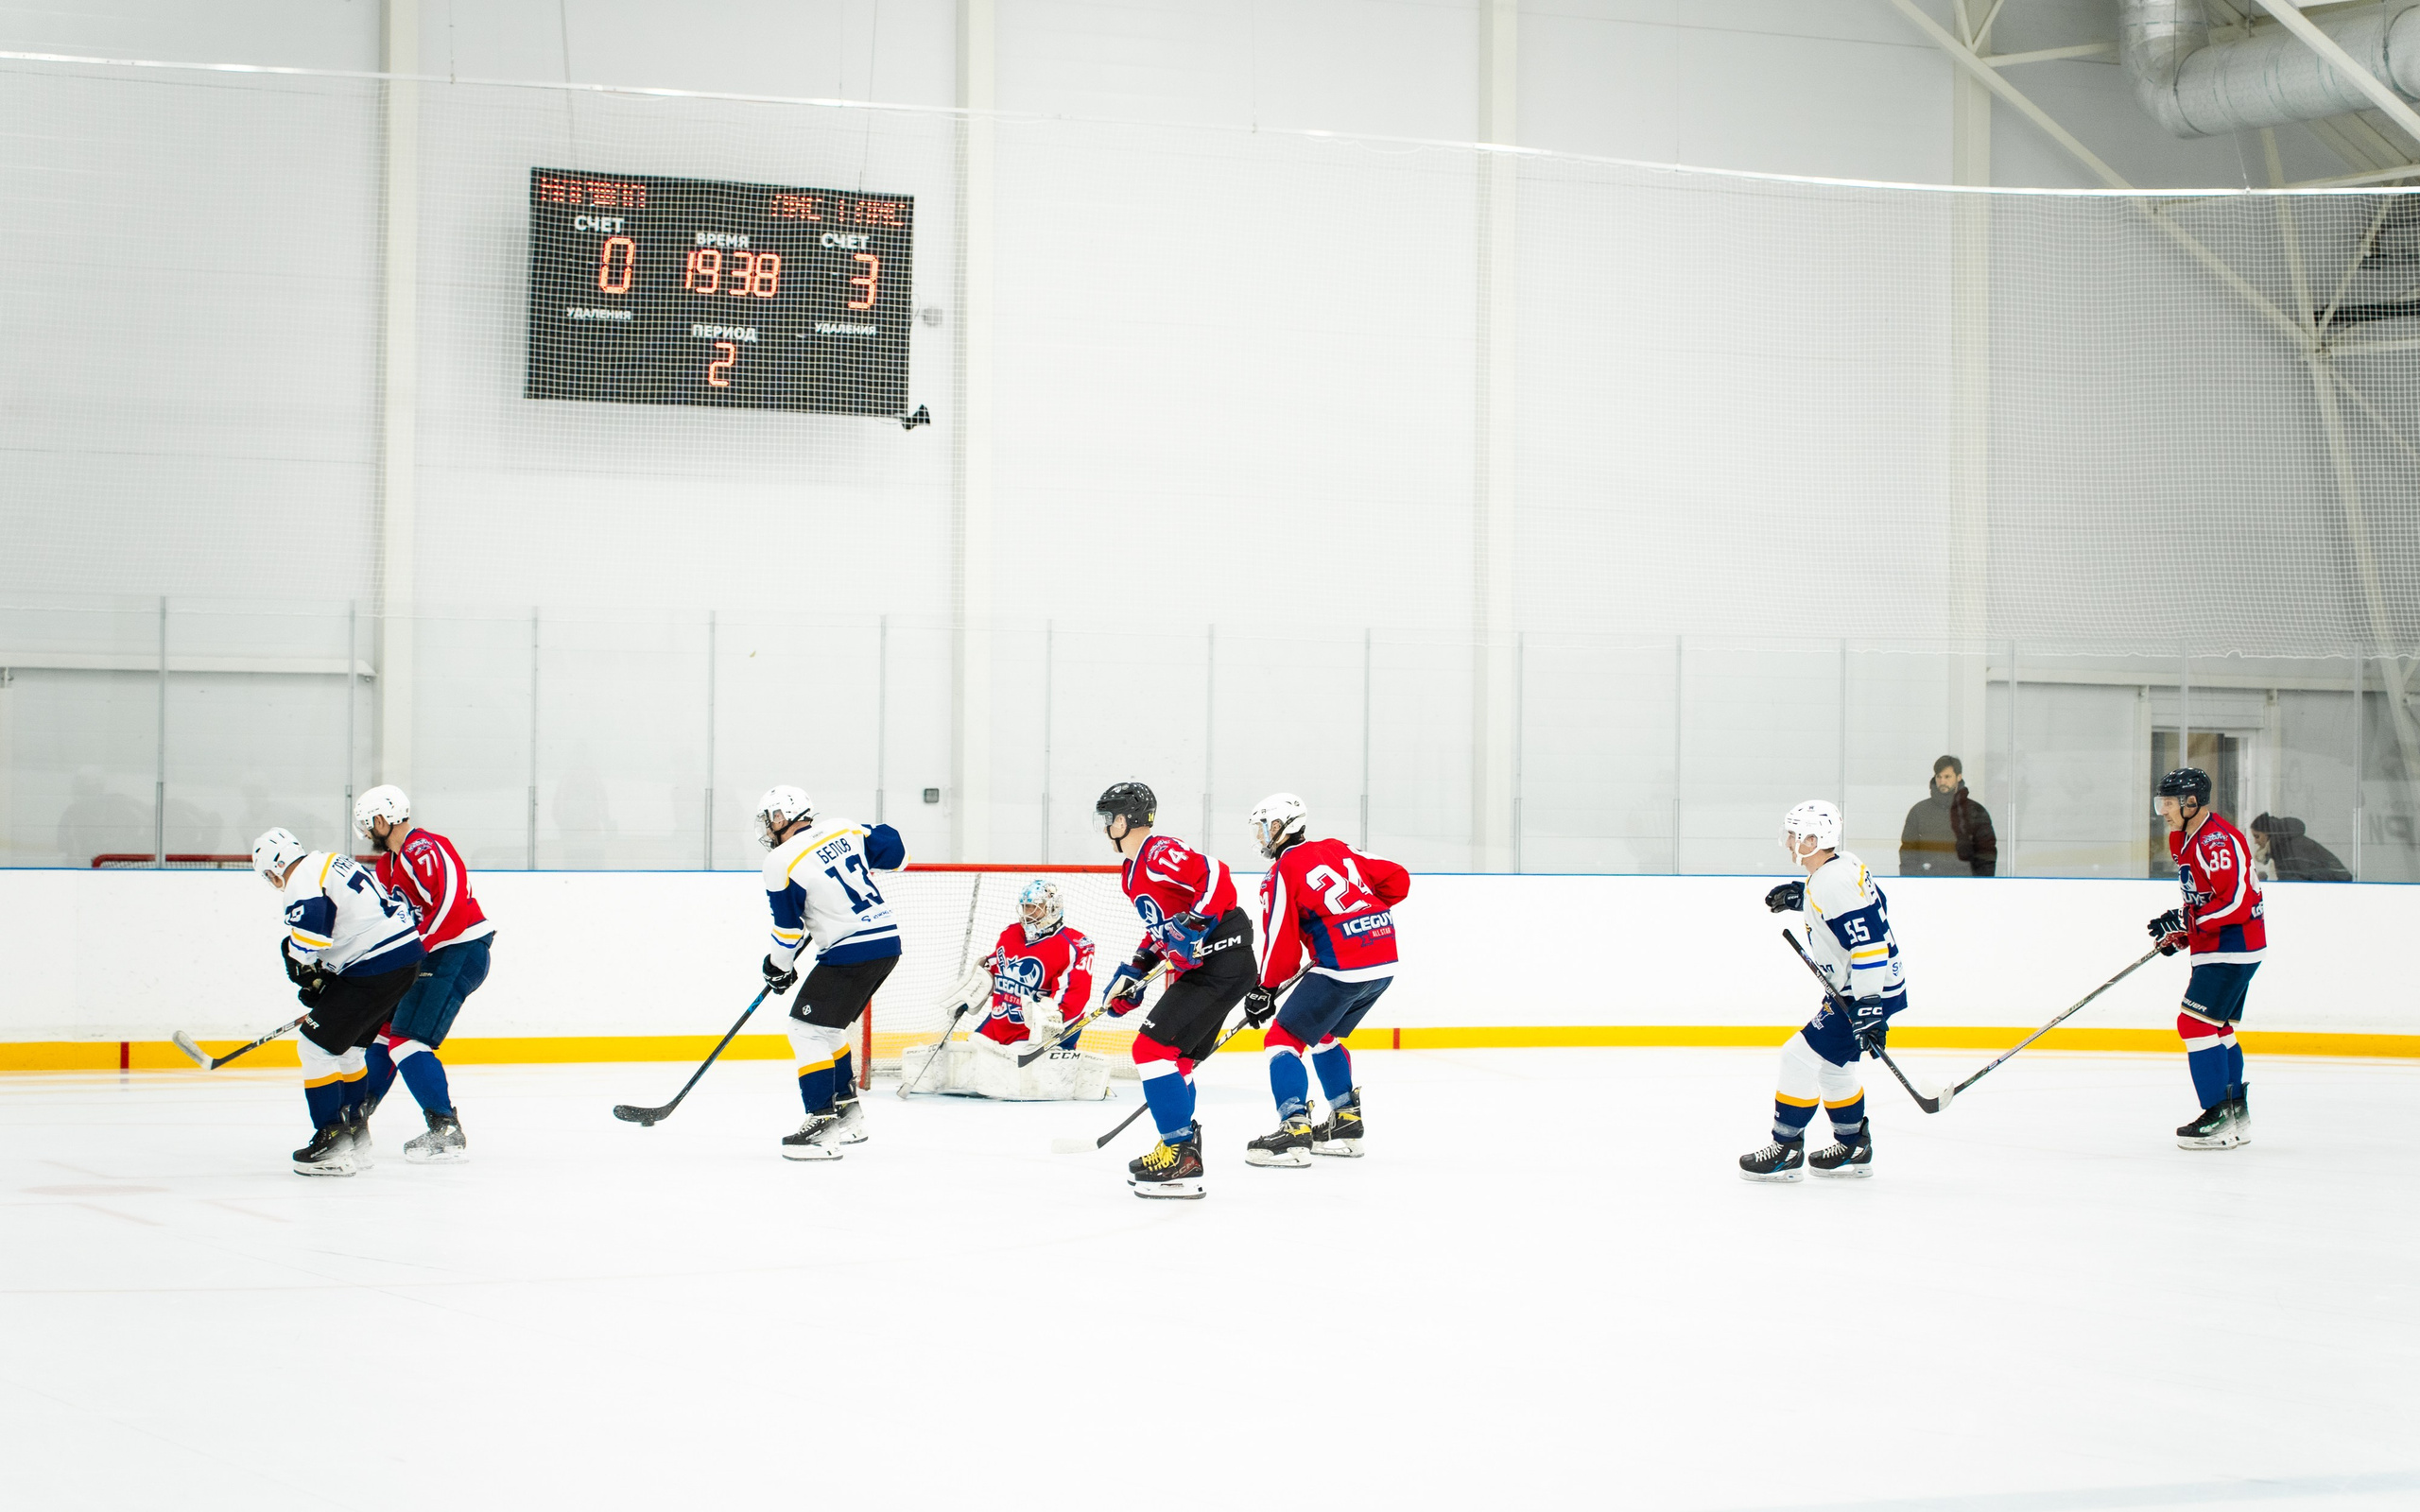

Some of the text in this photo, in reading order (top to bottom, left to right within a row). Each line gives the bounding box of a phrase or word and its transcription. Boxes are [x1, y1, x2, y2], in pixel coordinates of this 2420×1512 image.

[574, 215, 624, 233] СЧЕТ
[697, 232, 750, 248] ВРЕМЯ
[821, 232, 870, 249] СЧЕТ
[599, 237, 634, 294] 0
[848, 253, 879, 309] 3
[566, 306, 631, 320] УДАЛЕНИЯ
[692, 324, 756, 342] ПЕРИОД
[814, 322, 876, 335] УДАЛЕНИЯ
[708, 342, 735, 387] 2
[816, 837, 852, 865] БЕЛОВ
[1158, 849, 1188, 872] 14
[2209, 849, 2232, 872] 86
[417, 850, 440, 877] 71
[824, 853, 885, 915] 13
[1305, 857, 1373, 915] 24
[1342, 912, 1393, 936] ICEGUY
[1843, 917, 1871, 945] 55
[1075, 954, 1094, 976] 30
[1858, 1006, 1883, 1017] CC
[1172, 1160, 1195, 1178] CCM
